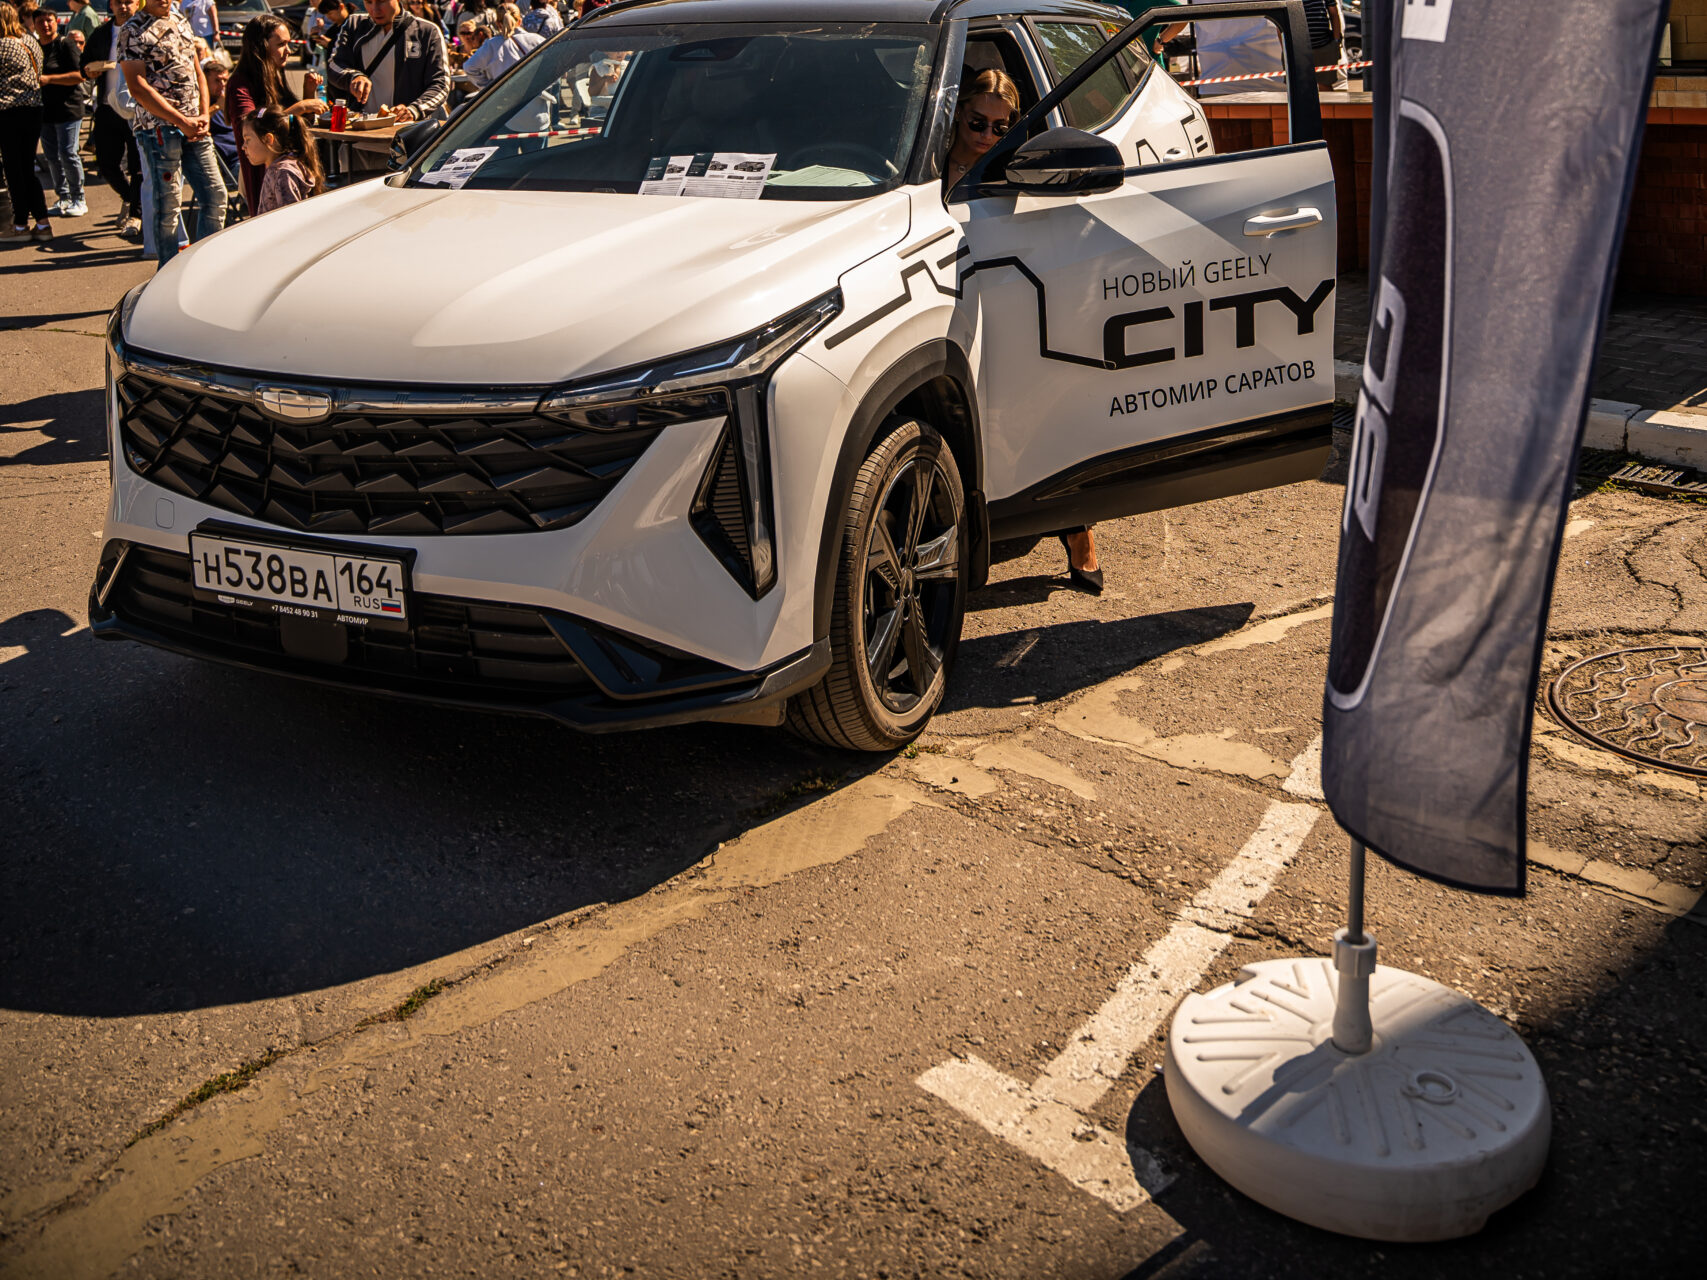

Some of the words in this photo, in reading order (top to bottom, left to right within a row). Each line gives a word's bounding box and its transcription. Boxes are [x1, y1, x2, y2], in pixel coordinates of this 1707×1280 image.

[1102, 259, 1195, 301] НОВЫЙ
[1203, 253, 1272, 283] GEELY
[1103, 278, 1335, 370] CITY
[1109, 378, 1218, 417] АВТОМИР
[1224, 360, 1315, 395] САРАТОВ
[339, 561, 393, 598] 164
[336, 613, 369, 625] АВТОМИР
[353, 596, 381, 610] RUS
